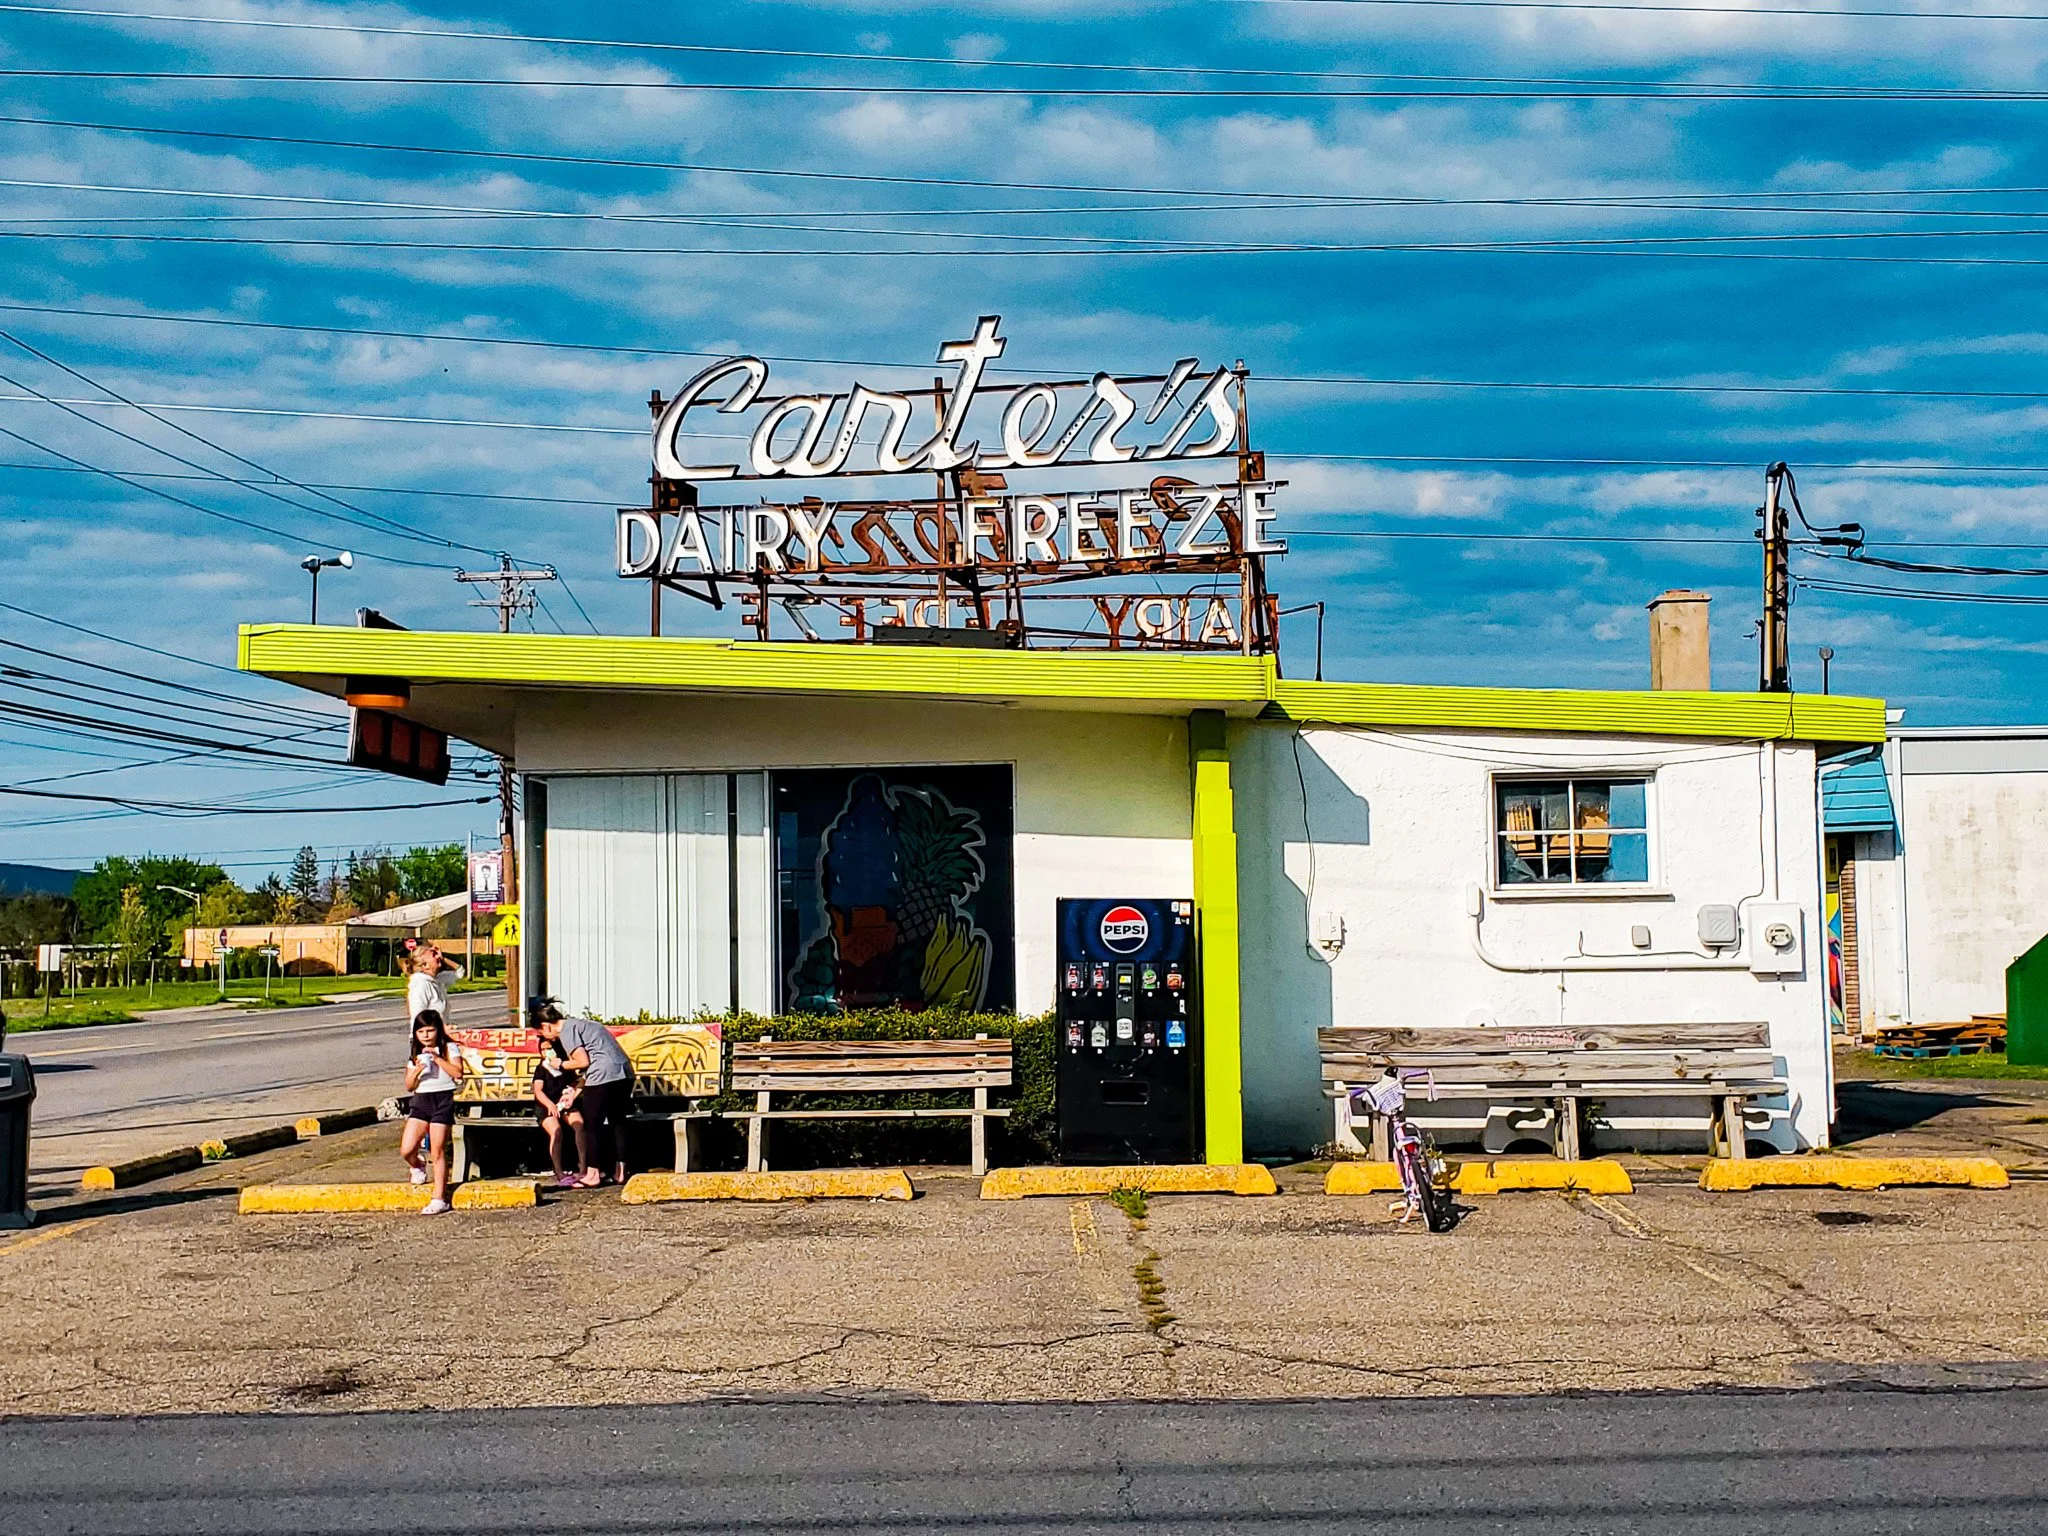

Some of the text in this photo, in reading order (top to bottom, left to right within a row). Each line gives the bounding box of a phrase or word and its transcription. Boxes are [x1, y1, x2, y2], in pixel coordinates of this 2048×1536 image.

[653, 314, 1241, 480] Carter's
[615, 501, 838, 578] DAIRY
[961, 480, 1290, 567] FREEZE
[1103, 925, 1145, 935] PEPSI
